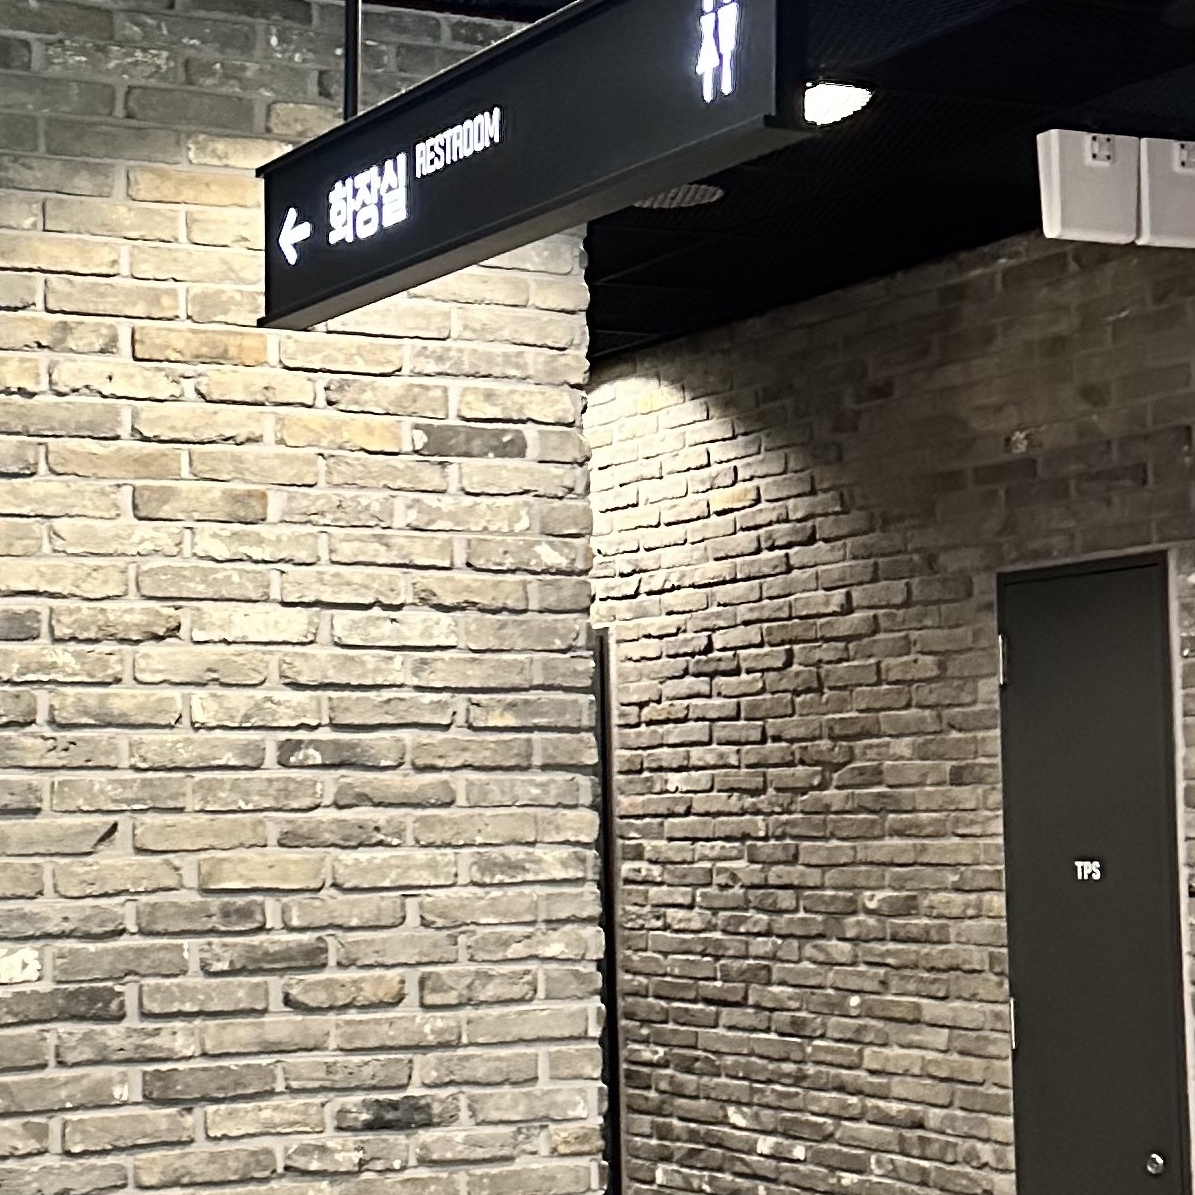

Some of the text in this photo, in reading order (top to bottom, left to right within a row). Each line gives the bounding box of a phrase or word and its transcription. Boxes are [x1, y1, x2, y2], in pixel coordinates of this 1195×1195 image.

[415, 106, 501, 178] RESTROOM
[329, 152, 408, 244] 화장실
[1074, 860, 1101, 880] TPS
